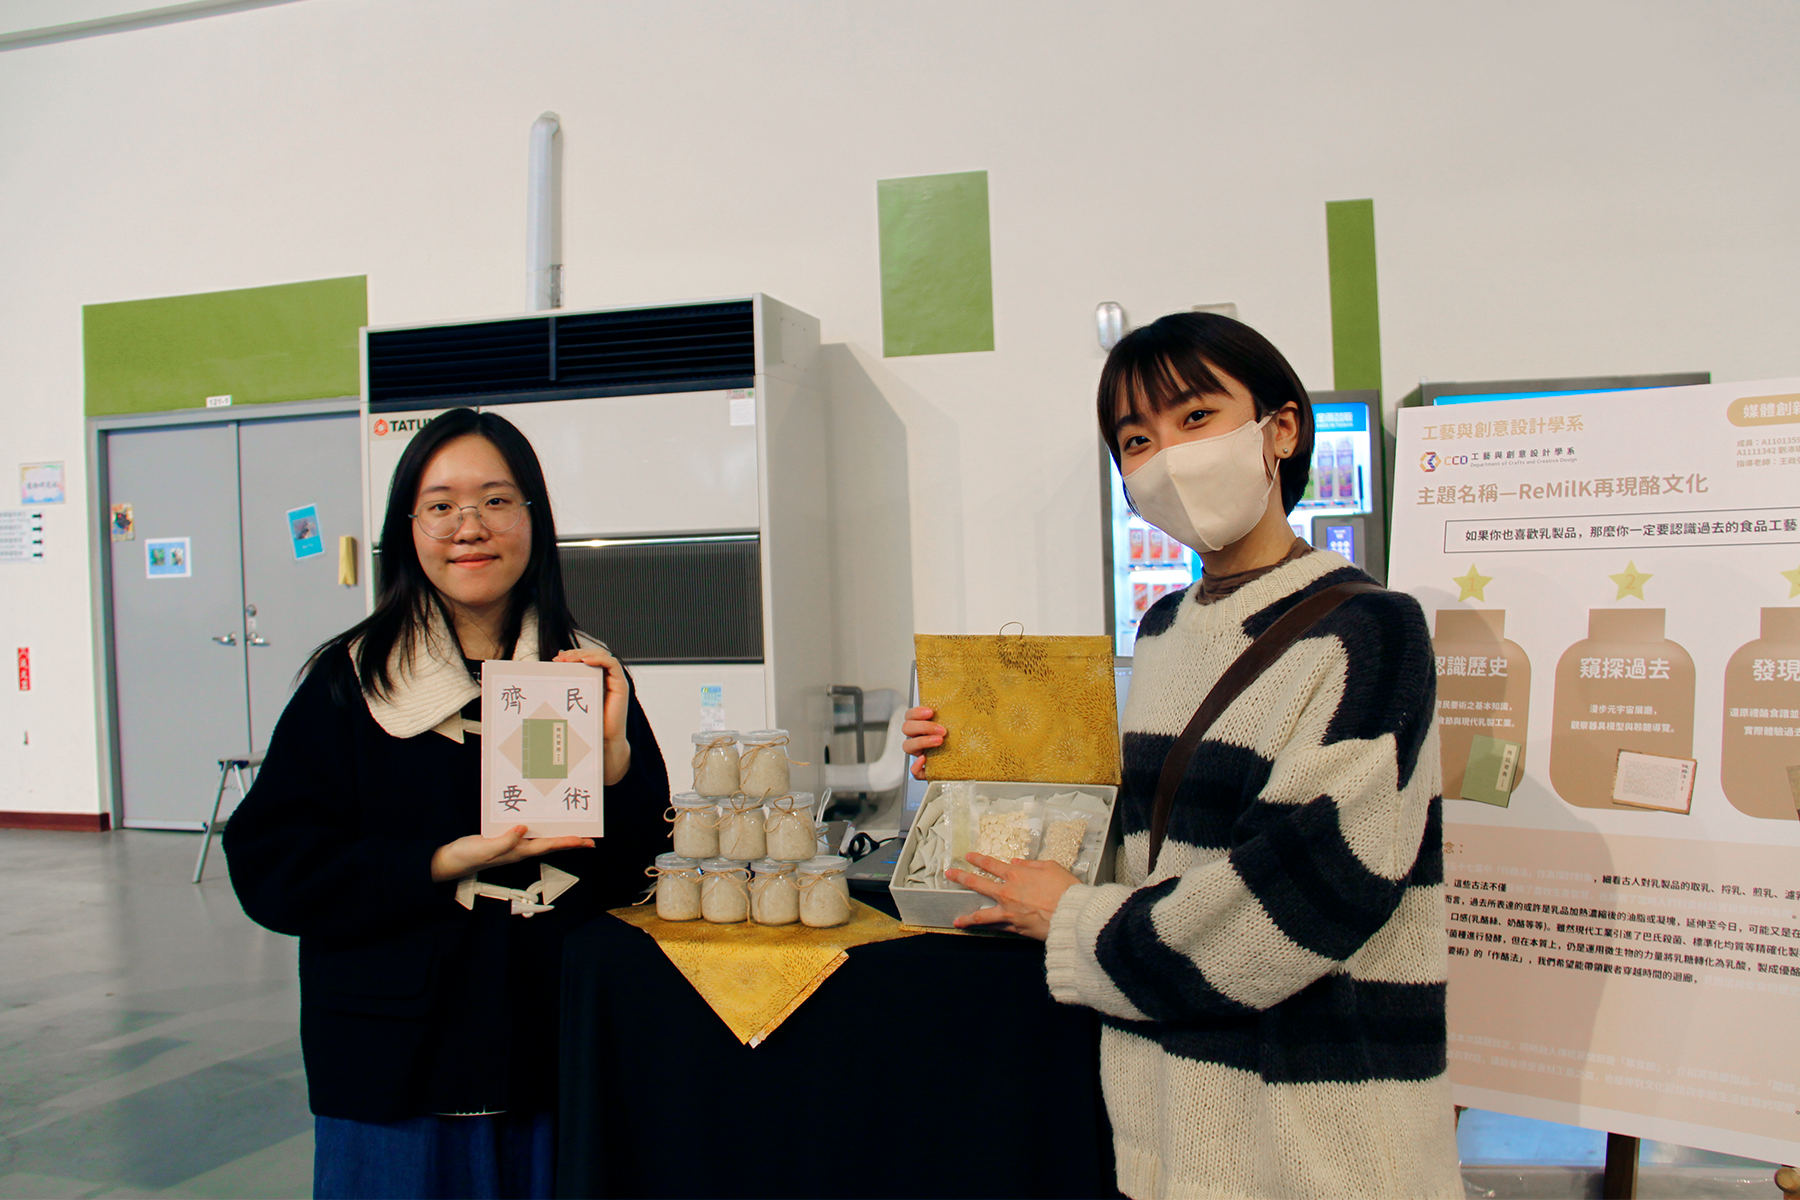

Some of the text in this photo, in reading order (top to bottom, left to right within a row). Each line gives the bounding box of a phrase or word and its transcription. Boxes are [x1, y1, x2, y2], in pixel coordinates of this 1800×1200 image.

[389, 418, 434, 432] TATU
[1421, 414, 1585, 441] 工藝與創意設計學系
[1471, 446, 1577, 461] 工藝與創意設計學系
[1468, 576, 1477, 592] 1
[1624, 574, 1636, 591] 2
[1579, 656, 1671, 680] 窺探過去
[1752, 658, 1800, 682] 發現
[501, 685, 589, 715] 齊 民
[498, 784, 591, 812] 要 術
